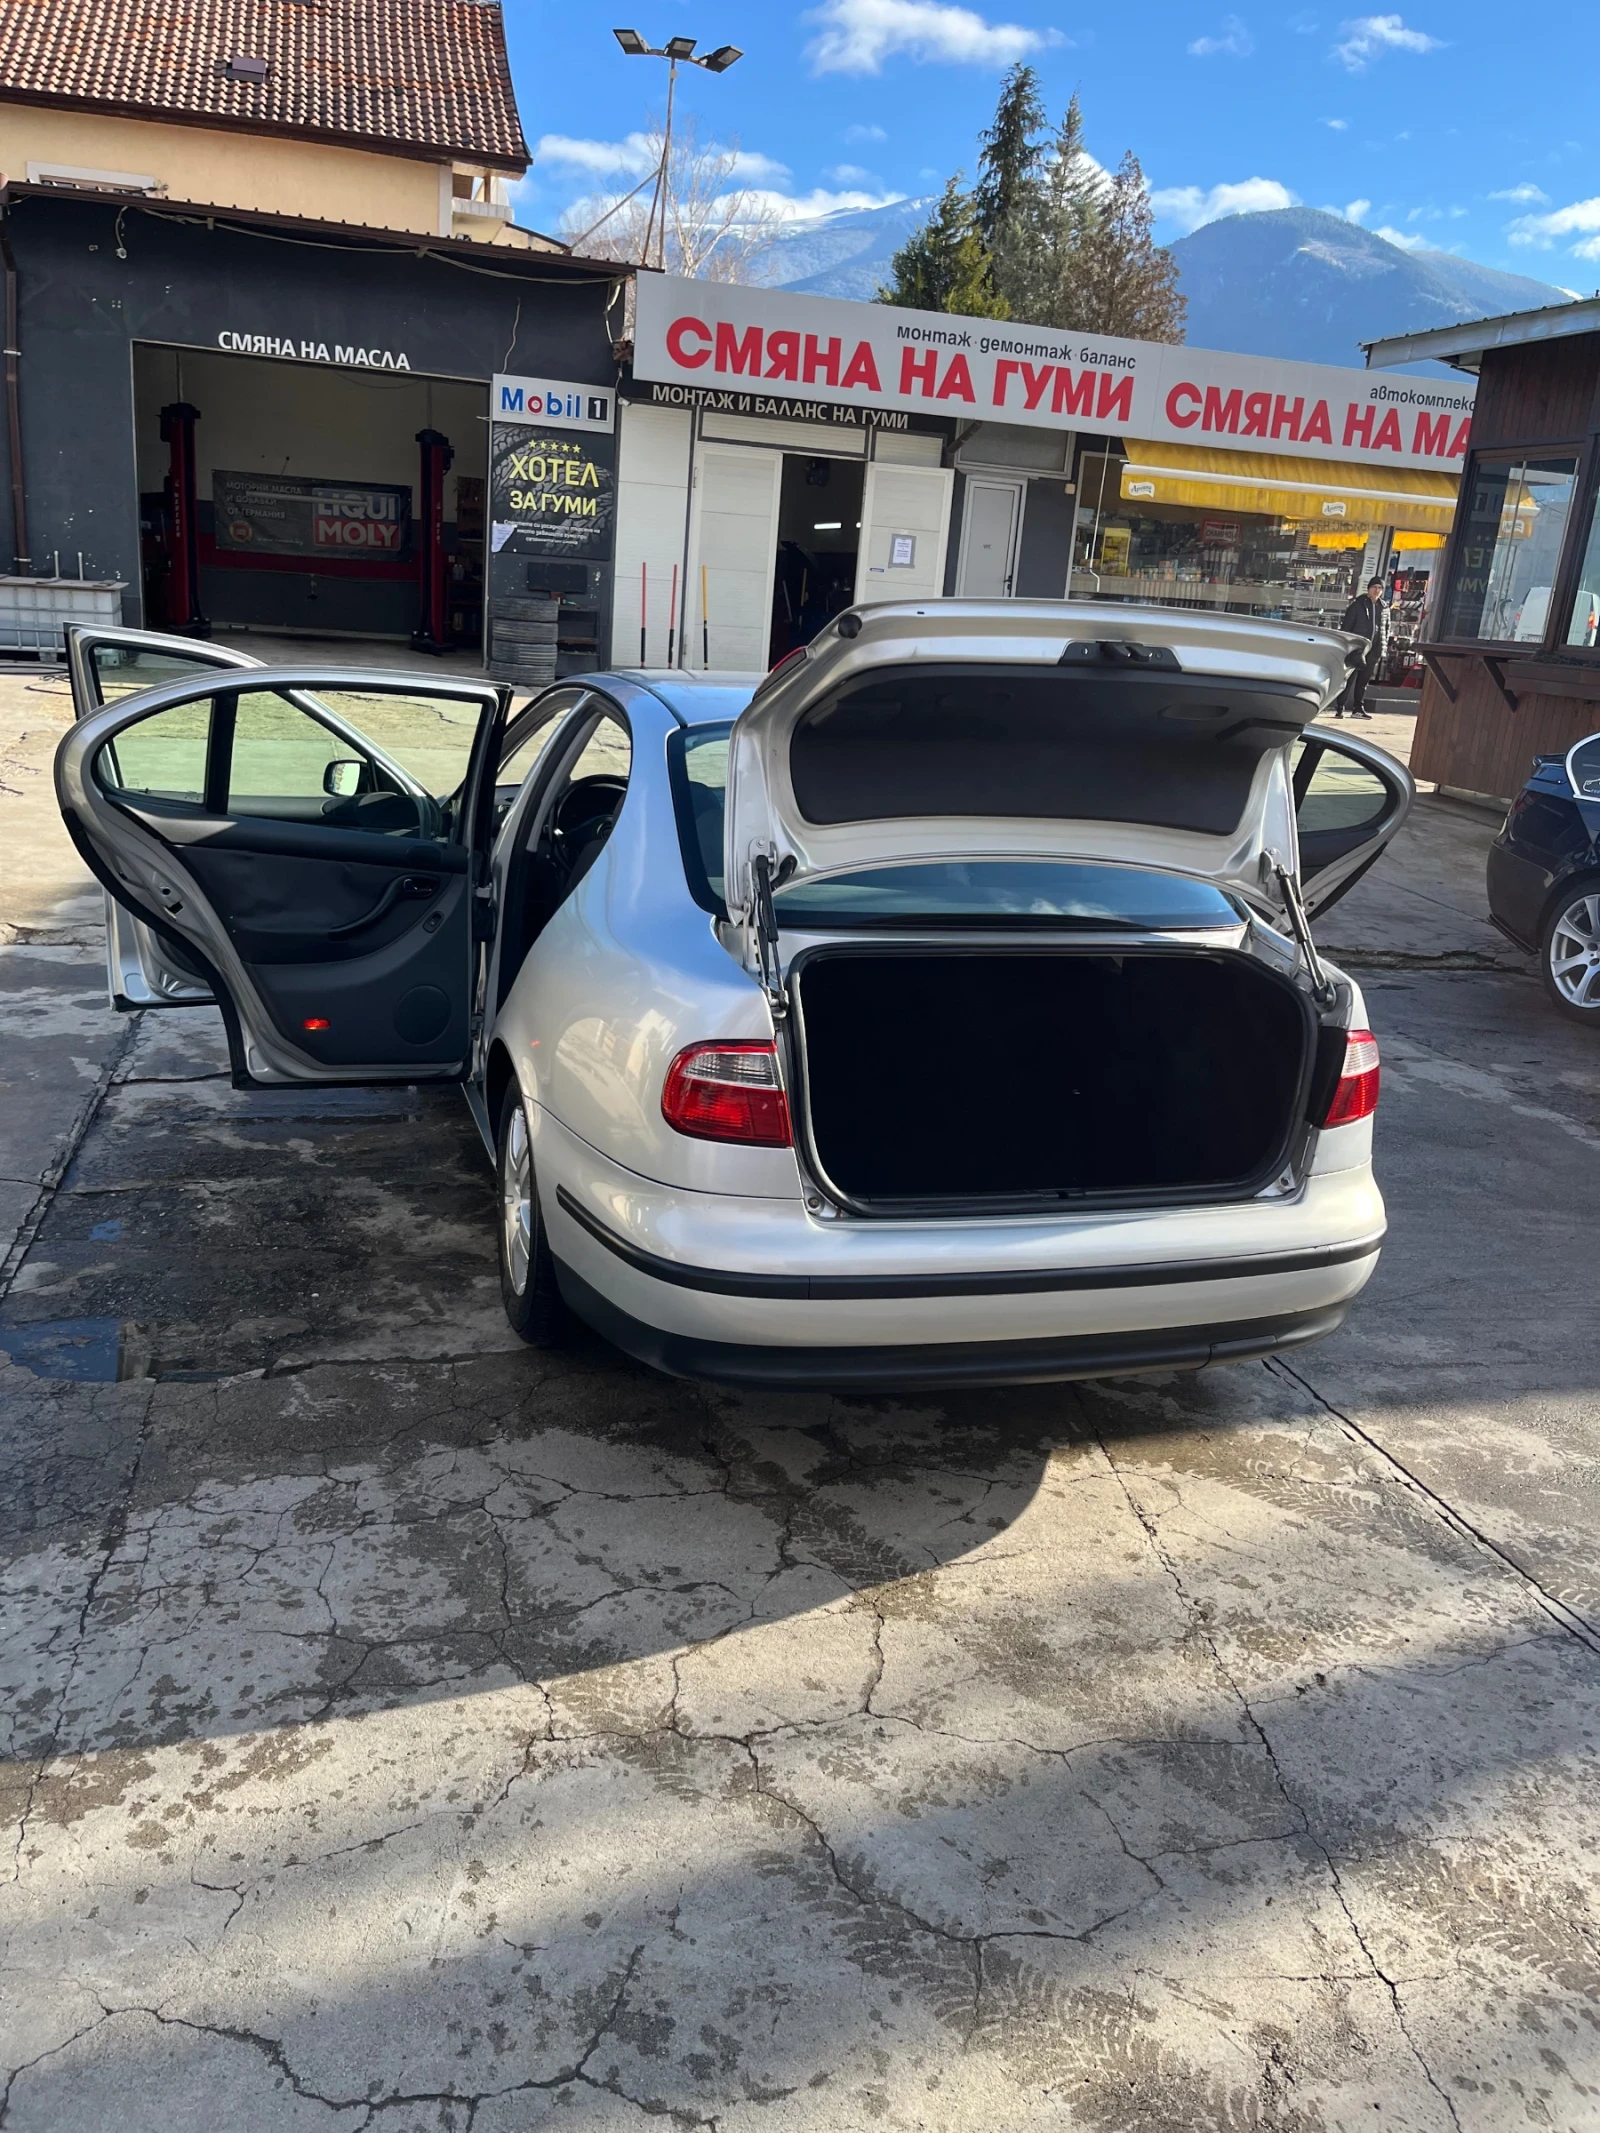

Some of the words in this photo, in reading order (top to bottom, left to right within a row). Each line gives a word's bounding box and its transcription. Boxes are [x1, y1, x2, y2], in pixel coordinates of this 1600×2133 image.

[217, 331, 297, 358] СМЯНА
[300, 340, 331, 362] НА
[334, 345, 411, 371] МАСЛА
[897, 325, 972, 347] монтаж
[980, 336, 1072, 361] демонтаж
[1079, 347, 1137, 370] баланс
[665, 316, 882, 393] СМЯНА
[898, 345, 977, 404] НА
[992, 358, 1135, 422] ГУМИ
[501, 386, 581, 419] Mobil
[652, 384, 735, 410] МОНТАЖ
[738, 394, 751, 412] И
[755, 397, 827, 420] БАЛАНС
[832, 406, 857, 425] НА
[861, 409, 909, 430] ГУМИ
[1165, 382, 1333, 445] СМЯНА
[1341, 402, 1402, 453] НА
[508, 453, 600, 488] ХОТЕЛ
[226, 481, 269, 492] МОТОРНИ
[271, 485, 303, 495] МАСЛА
[509, 490, 538, 511] ЗА
[541, 493, 597, 516] ГУМИ
[227, 506, 239, 515] ОТ
[241, 508, 286, 519] ГЕРМАНИЯ
[318, 490, 396, 521] LIQUI
[318, 519, 398, 547] MOLY
